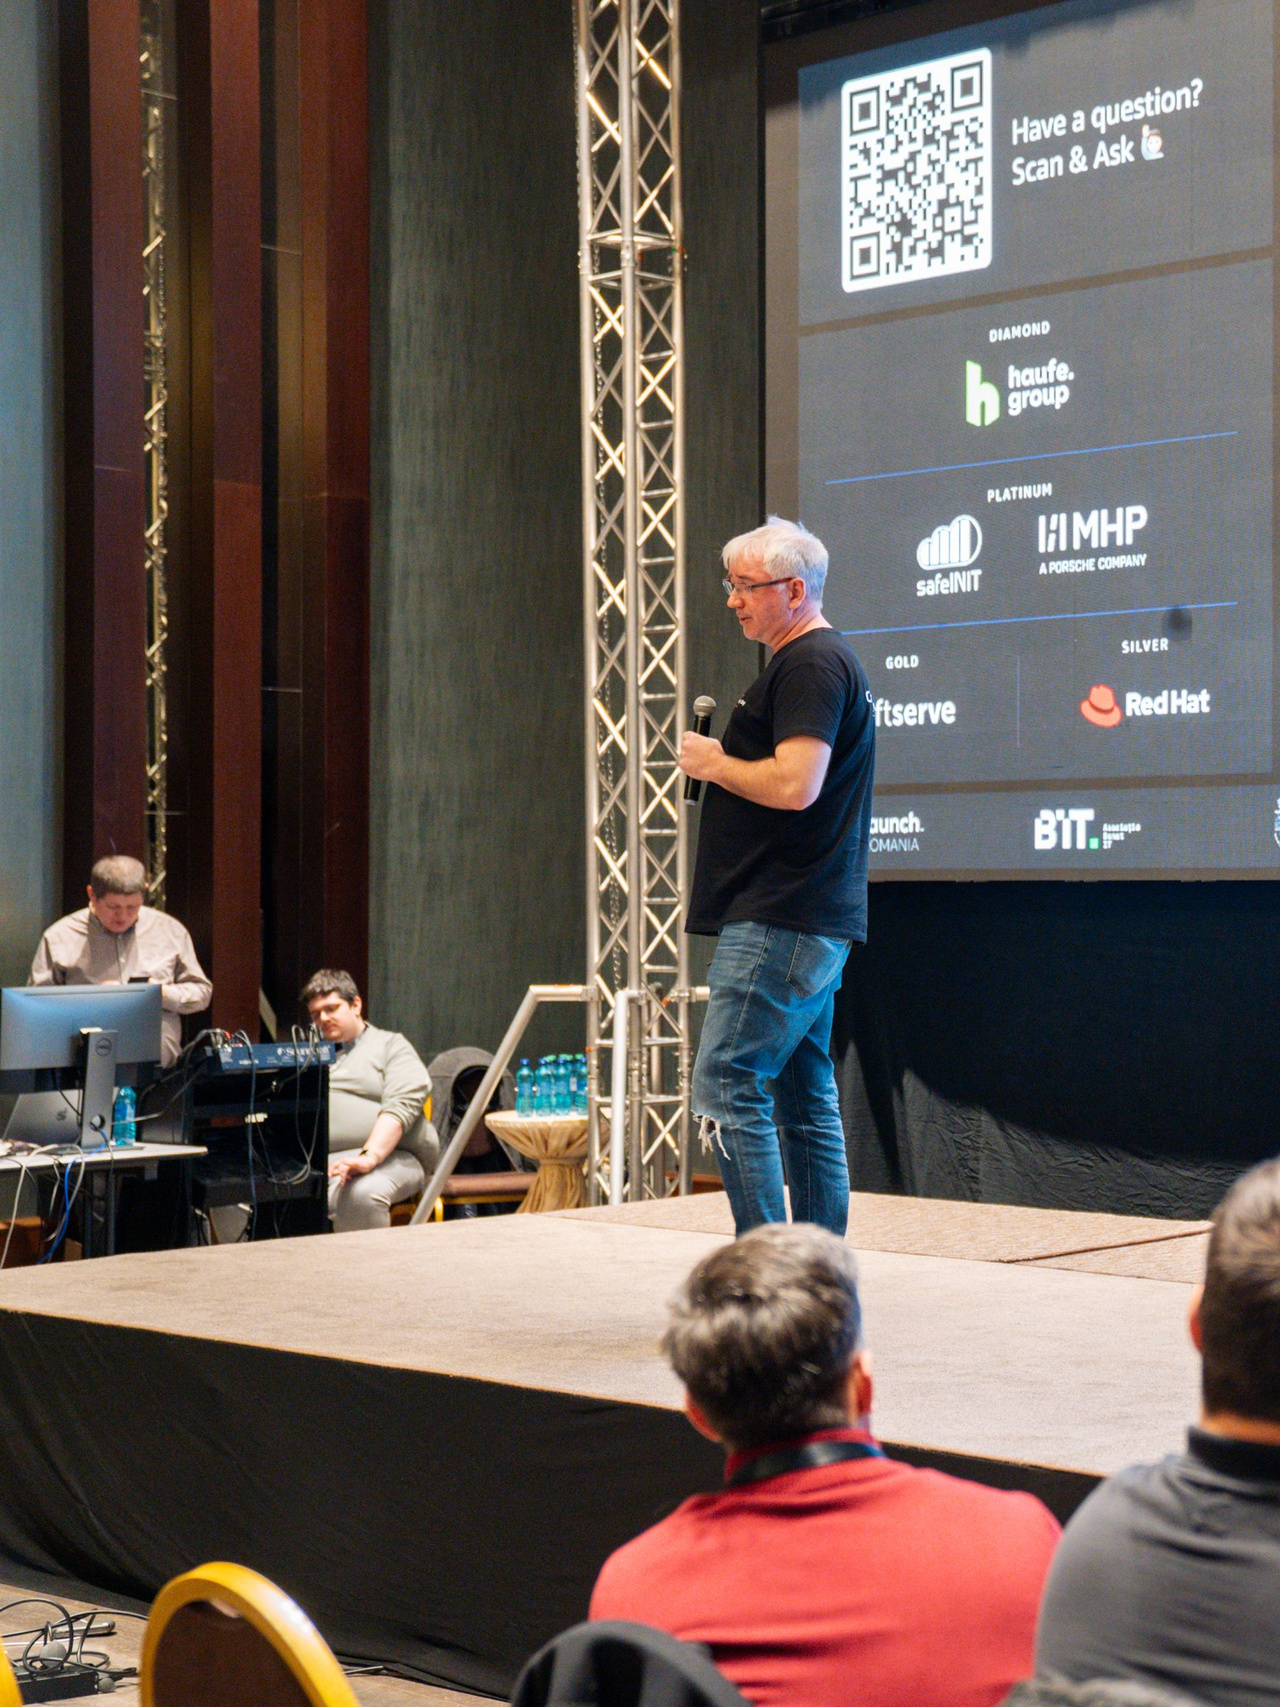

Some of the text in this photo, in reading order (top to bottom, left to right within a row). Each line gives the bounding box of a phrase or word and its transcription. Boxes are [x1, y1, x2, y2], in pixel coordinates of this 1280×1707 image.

[1011, 77, 1204, 146] Have a question?
[1011, 134, 1135, 186] Scan & Ask
[988, 320, 1051, 343] DIAMOND
[1007, 357, 1075, 390] haufe.
[1007, 384, 1070, 417] group
[986, 482, 1053, 503] PLATINUM
[1072, 504, 1148, 551] MHP
[1038, 553, 1148, 575] A PORSCHE COMPANY
[916, 568, 983, 597] safeINIT
[1121, 636, 1169, 654] SILVER
[885, 654, 919, 670] GOLD
[874, 696, 957, 728] ftserve
[1125, 688, 1211, 717] Red Hat
[869, 810, 925, 834] aunch.
[868, 837, 920, 853] OMANIA
